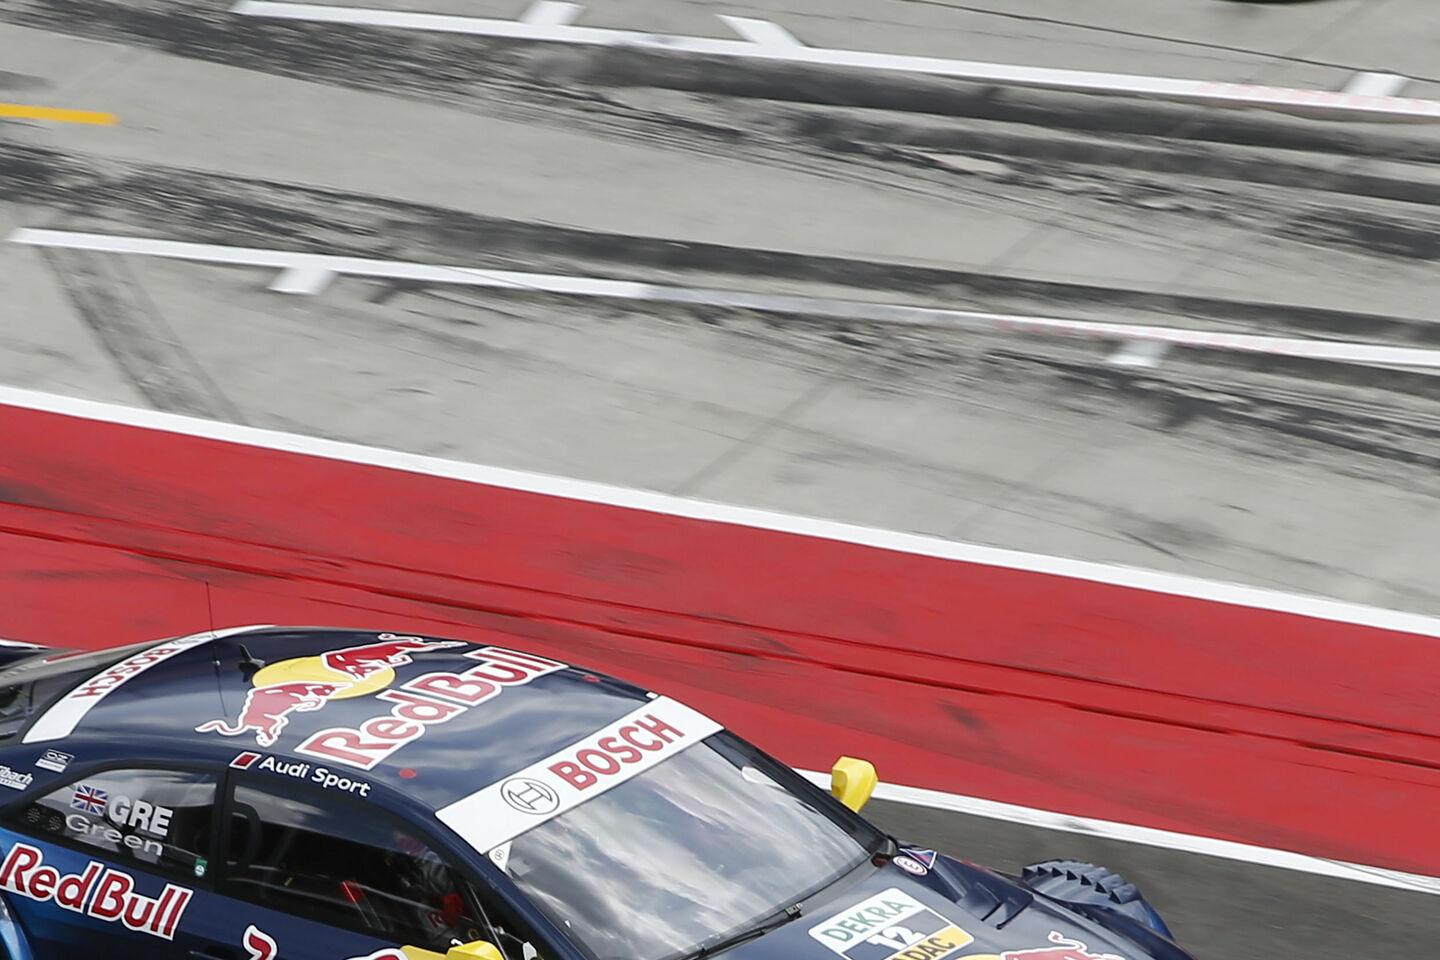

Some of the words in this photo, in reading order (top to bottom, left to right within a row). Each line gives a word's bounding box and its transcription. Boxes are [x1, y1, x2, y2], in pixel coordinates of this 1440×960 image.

[72, 648, 180, 698] BOSCH
[548, 714, 685, 791] BOSCH
[258, 756, 310, 778] Audi
[311, 768, 371, 797] Sport
[65, 814, 164, 856] Green
[109, 795, 173, 836] GRE
[820, 900, 914, 942] DEKRA
[866, 926, 926, 950] 12
